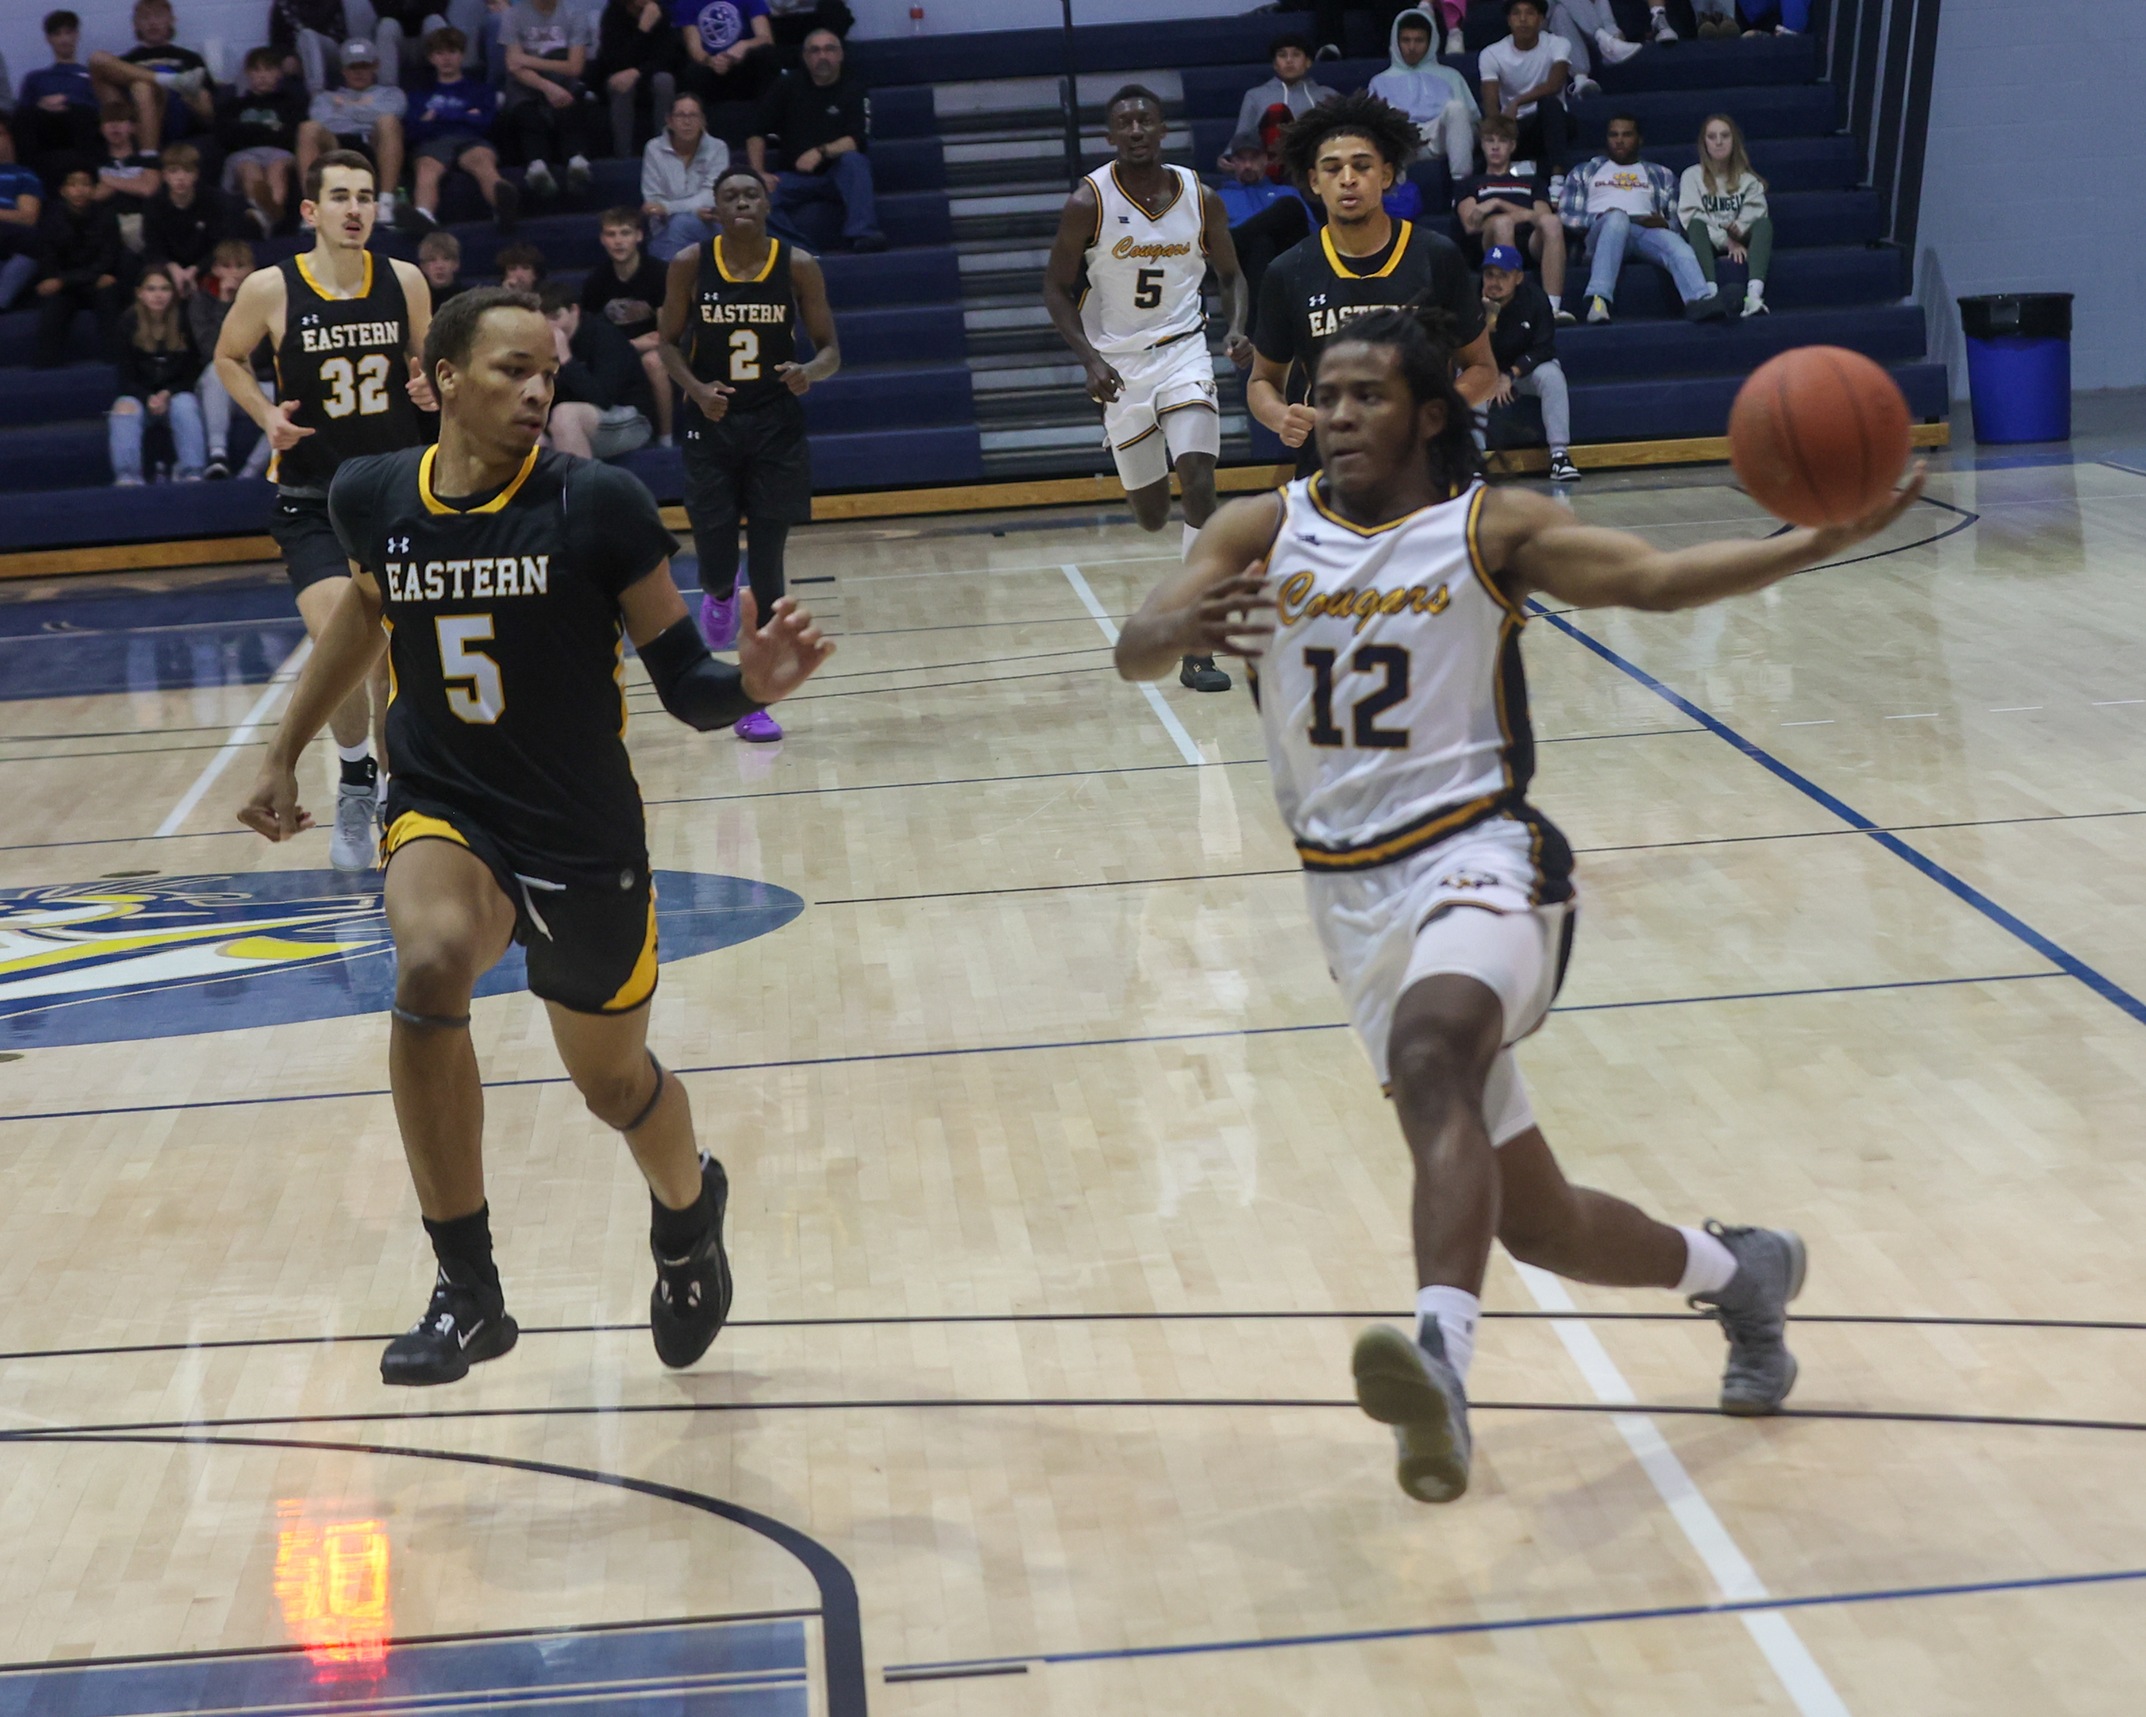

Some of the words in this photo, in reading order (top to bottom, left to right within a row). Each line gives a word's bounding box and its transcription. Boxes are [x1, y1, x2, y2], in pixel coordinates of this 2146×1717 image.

[1111, 235, 1191, 265] Cougars
[1134, 268, 1165, 309] 5
[301, 320, 399, 352] EASTERN
[700, 303, 786, 324] EASTERN
[728, 329, 760, 381] 2
[319, 353, 391, 419] 32
[385, 555, 549, 602] EASTERN
[1276, 570, 1451, 636] Cougars
[434, 612, 506, 725] 5
[1303, 644, 1412, 750] 12
